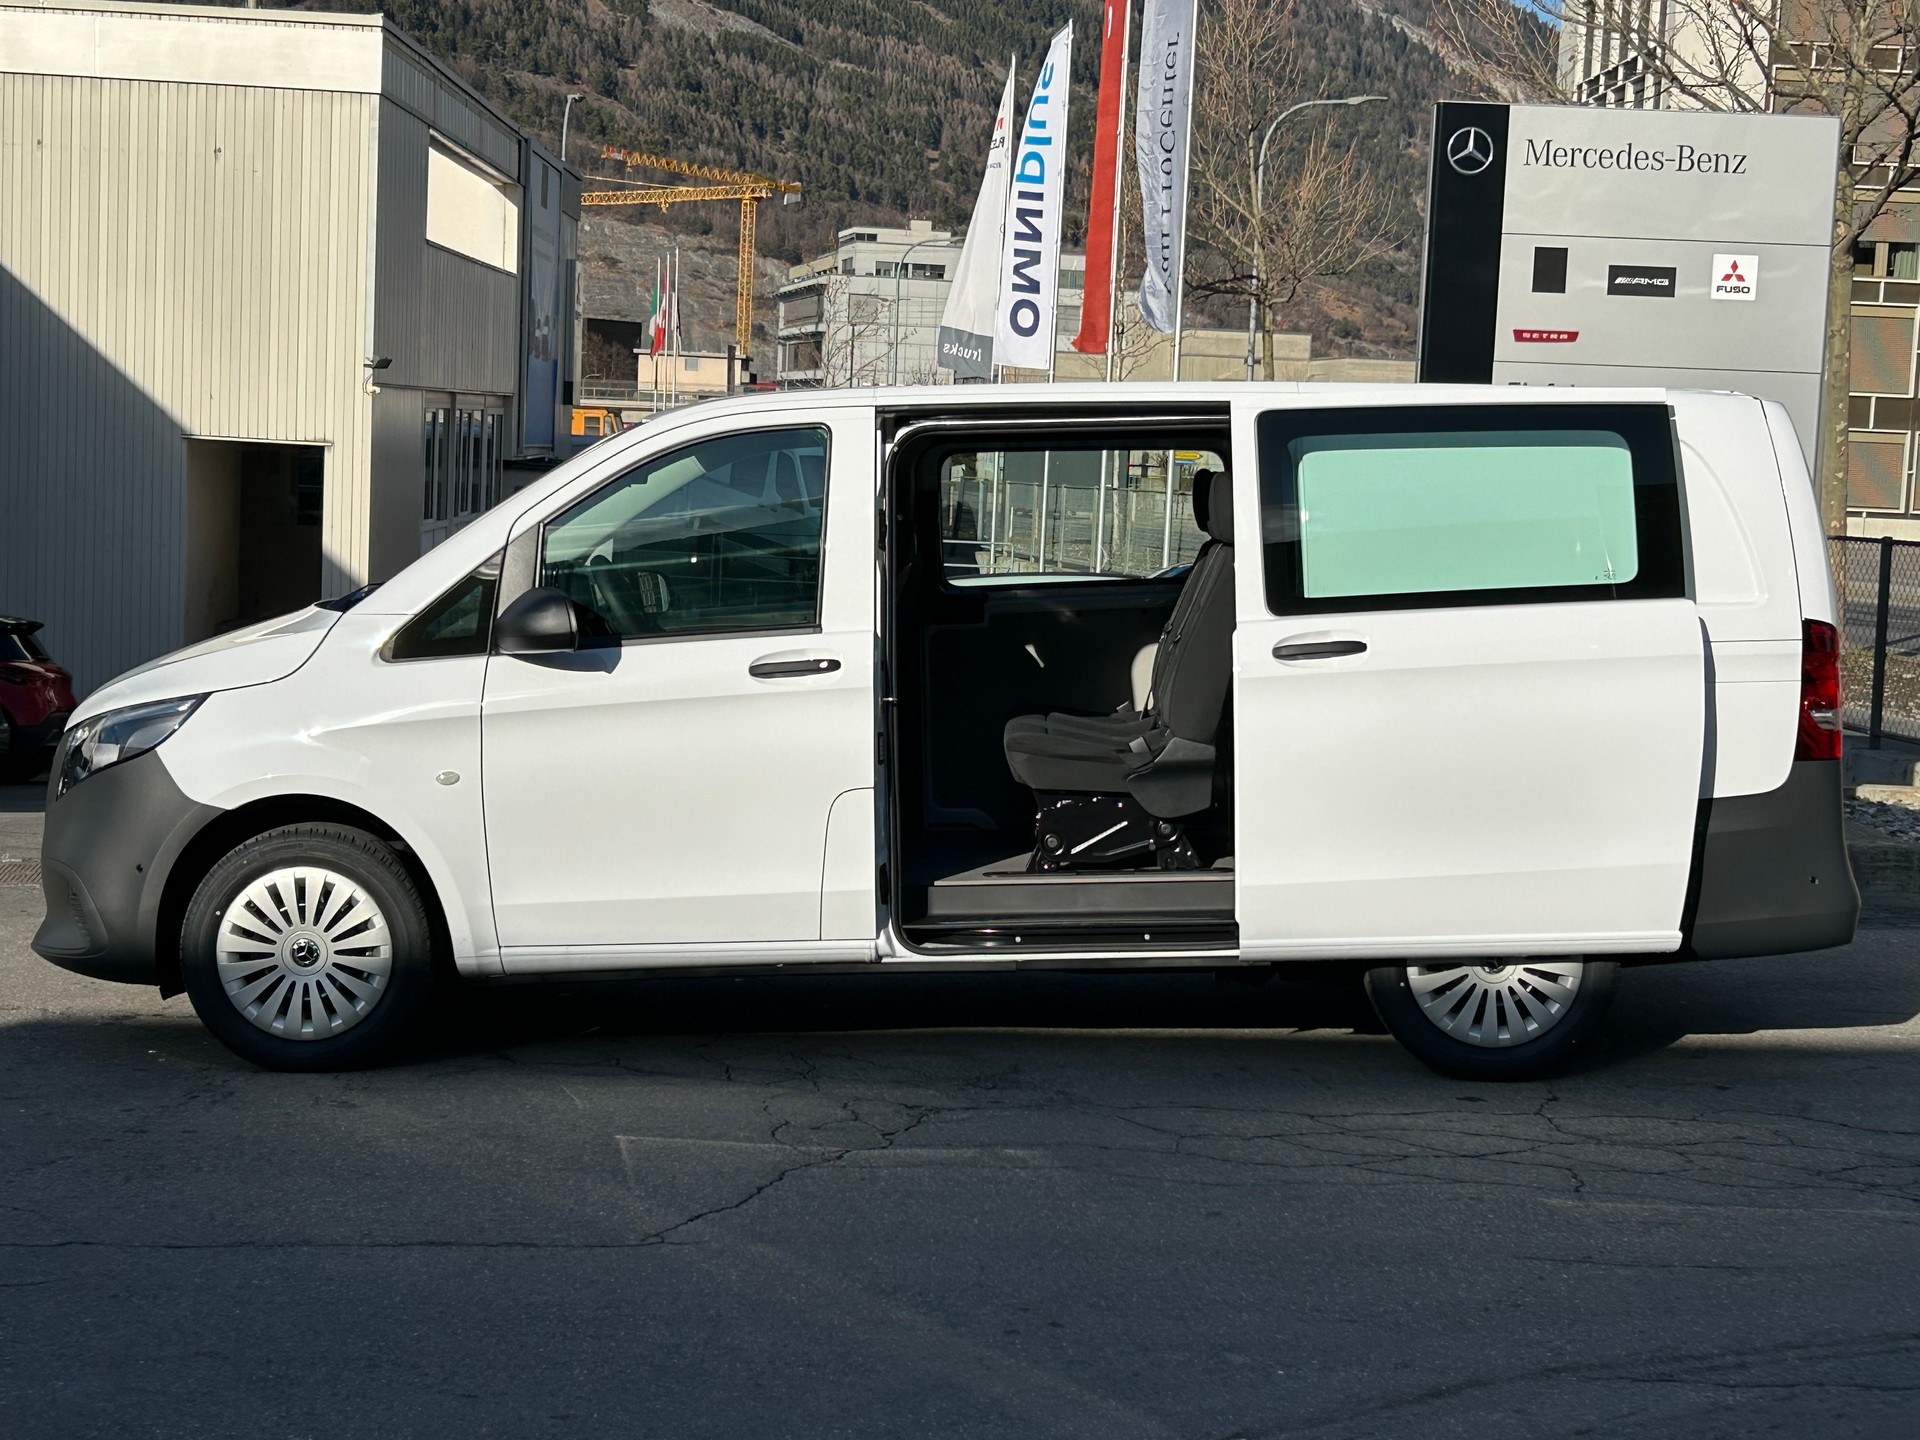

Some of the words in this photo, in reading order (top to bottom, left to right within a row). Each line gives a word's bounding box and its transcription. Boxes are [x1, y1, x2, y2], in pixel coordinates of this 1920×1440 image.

[1523, 138, 1748, 175] Mercedes-Benz
[1632, 277, 1669, 286] AMG
[1716, 285, 1751, 294] FUSO
